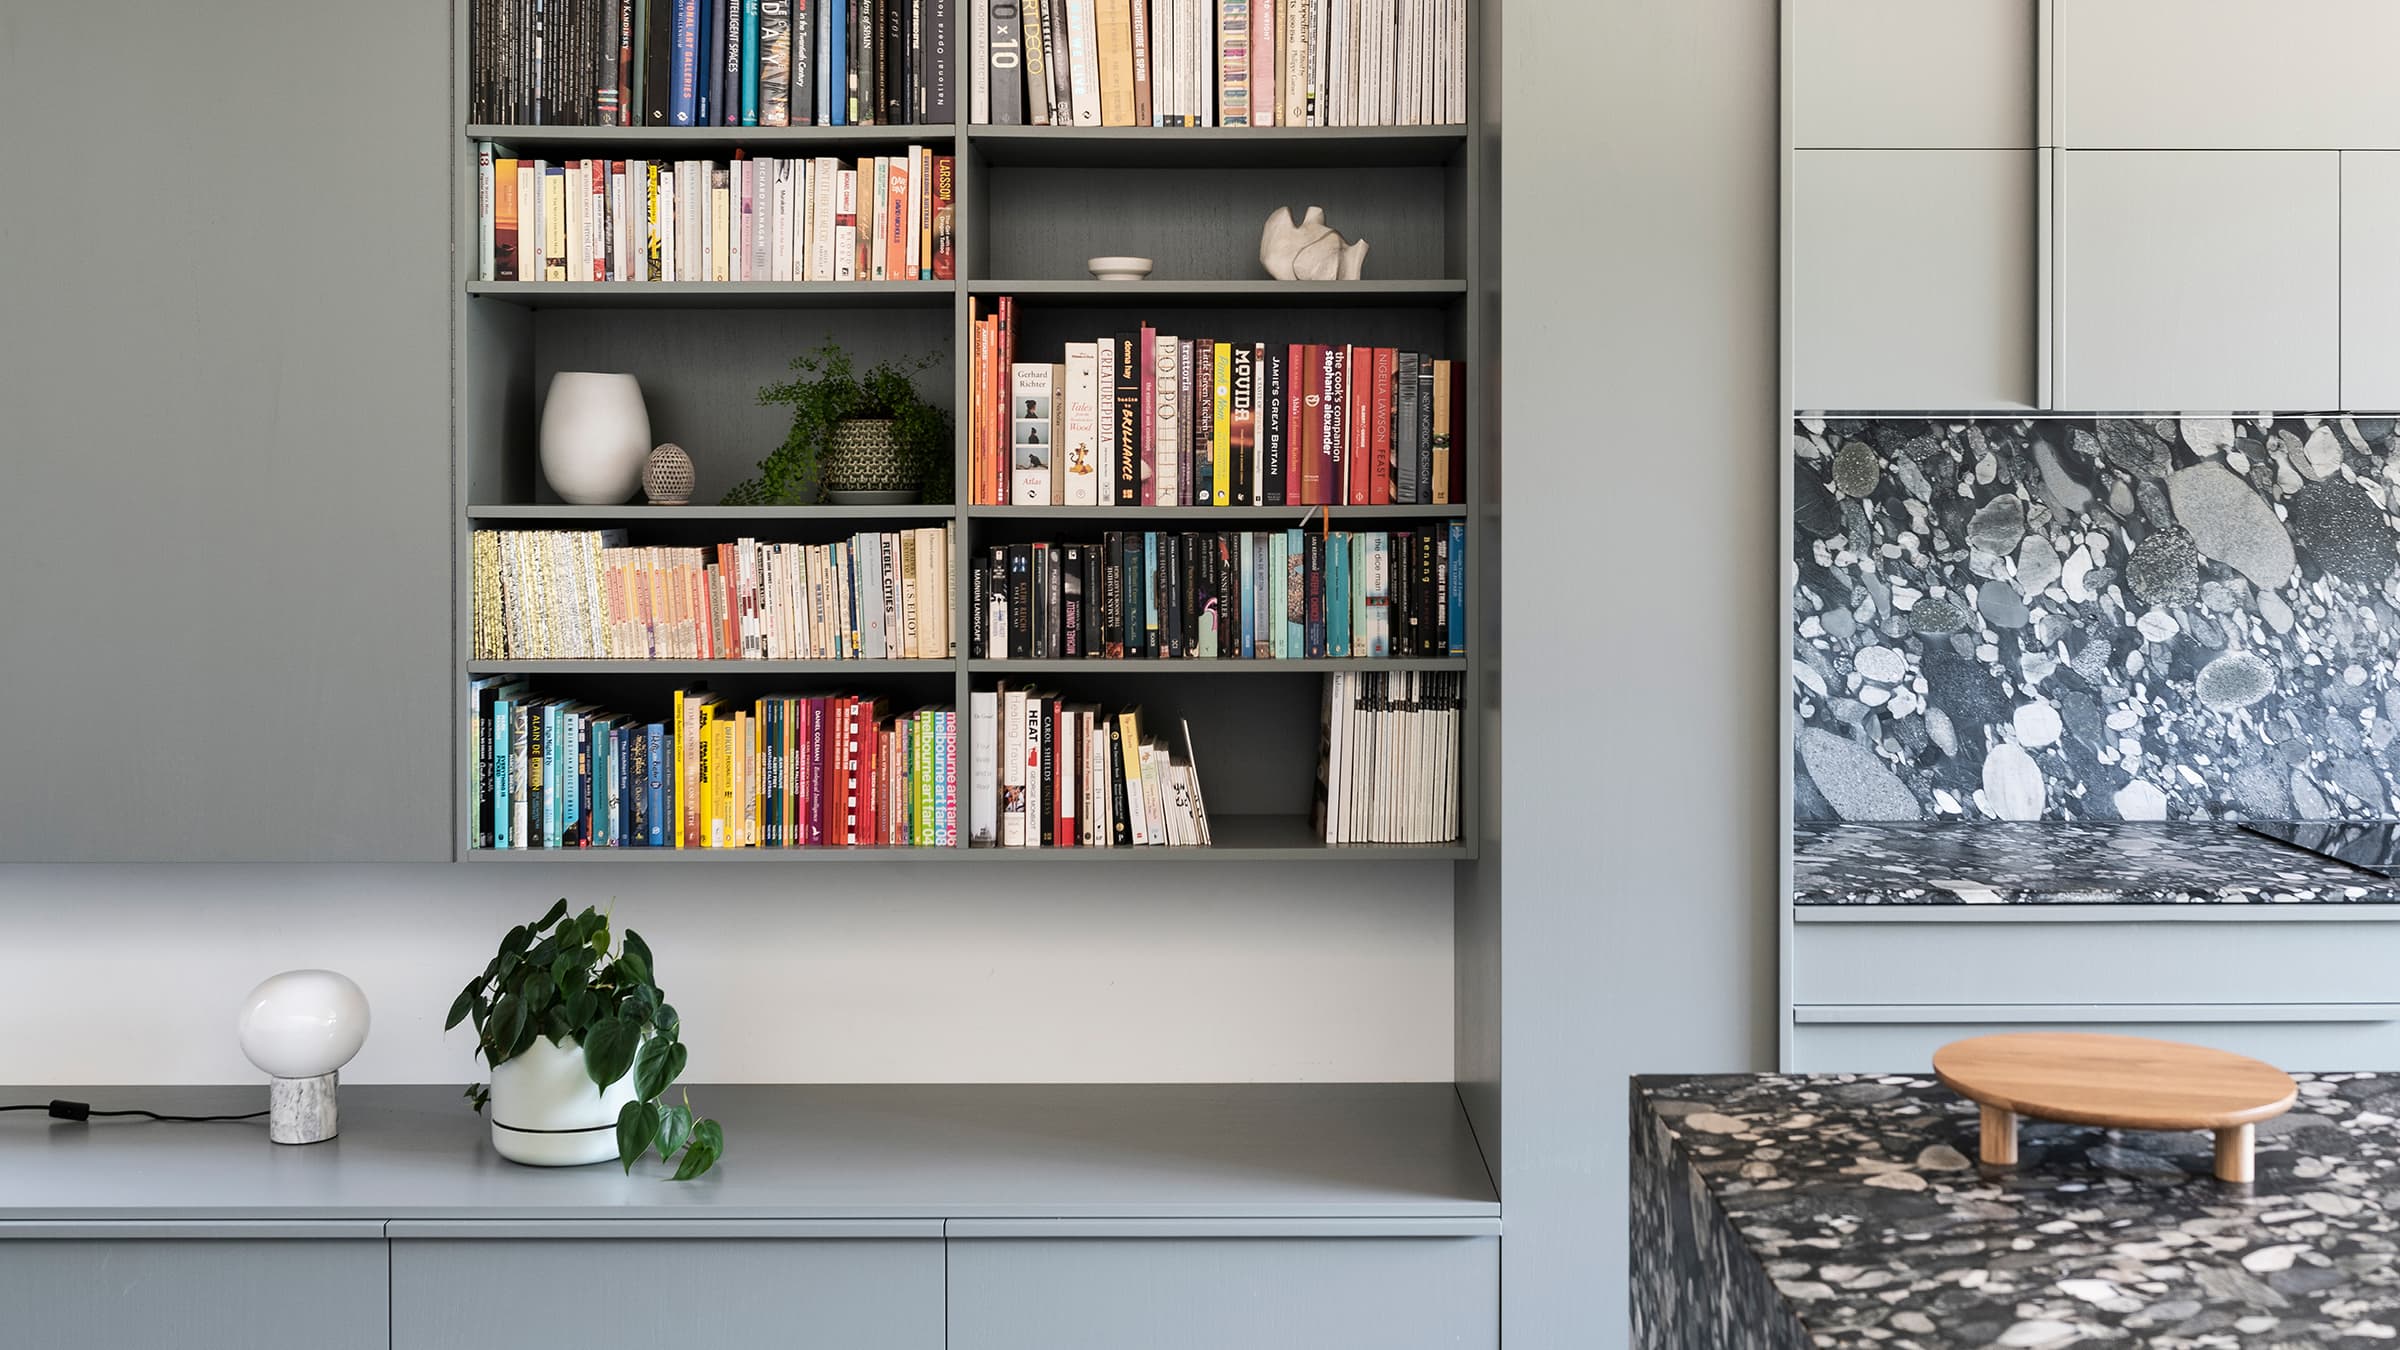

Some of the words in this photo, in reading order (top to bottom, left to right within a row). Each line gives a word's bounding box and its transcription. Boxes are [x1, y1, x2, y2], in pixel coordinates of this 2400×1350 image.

[799, 21, 808, 31] the
[863, 16, 871, 25] of
[997, 25, 1008, 34] x
[685, 32, 694, 48] ART
[799, 32, 807, 60] Twentieth
[863, 26, 871, 49] SPAIN
[1024, 24, 1043, 75] DECO
[728, 44, 738, 72] SPACES
[992, 39, 1018, 69] 10
[1136, 49, 1145, 57] IN
[683, 52, 692, 98] GALLERIES
[797, 62, 806, 87] Century
[1136, 59, 1146, 81] SPAIN
[480, 152, 489, 166] 13
[939, 159, 950, 200] LARSSON
[1124, 341, 1132, 364] donna
[1202, 349, 1211, 371] Little
[1334, 352, 1344, 369] the
[1018, 371, 1048, 380] Gerhard
[1122, 365, 1132, 379] hay
[1182, 344, 1192, 391] trattoria
[1271, 356, 1280, 396] JAMIE'S
[1323, 350, 1334, 401] stephanie
[1378, 353, 1387, 395] NIGELLA
[1020, 380, 1046, 388] Richter
[1101, 349, 1113, 443] CREATUREPEDIA
[1157, 344, 1176, 420] POLPO
[1202, 372, 1211, 398] Green
[1234, 349, 1251, 422] MOVIDA
[1334, 371, 1343, 402] cook's
[1201, 399, 1211, 431] Kitchen
[1271, 398, 1280, 432] GREAT
[1322, 403, 1333, 455] alexander
[1377, 398, 1386, 442] LAWSON
[1122, 409, 1133, 481] BRILLIANCE
[1332, 405, 1341, 462] companion
[1270, 434, 1279, 475] BRITAIN
[1377, 450, 1386, 478] FEAST
[1421, 451, 1429, 484] DESIGN
[1024, 478, 1041, 486] Atlas
[883, 542, 892, 576] REBEL
[1422, 536, 1430, 583] Benang
[885, 578, 893, 613] CITIES
[1066, 601, 1075, 628] CONNELLY
[1067, 630, 1075, 654] MICHAEL
[532, 715, 540, 741] ALAIN
[1008, 696, 1021, 738] Healing
[1029, 710, 1038, 742] HEAT
[532, 744, 540, 755] DE
[922, 711, 934, 783] melbourne
[936, 712, 946, 783] melbourne
[947, 712, 956, 783] melbourne
[531, 757, 540, 791] BOTTON
[545, 757, 553, 766] Fly
[1010, 743, 1021, 782] Trauma
[688, 787, 695, 800] ON
[923, 784, 933, 805] art
[936, 784, 946, 805] art
[947, 784, 956, 805] art
[923, 806, 934, 828] fair
[936, 806, 946, 828] fair
[947, 807, 956, 829] fair
[923, 829, 933, 845] 04
[936, 829, 946, 846] 08
